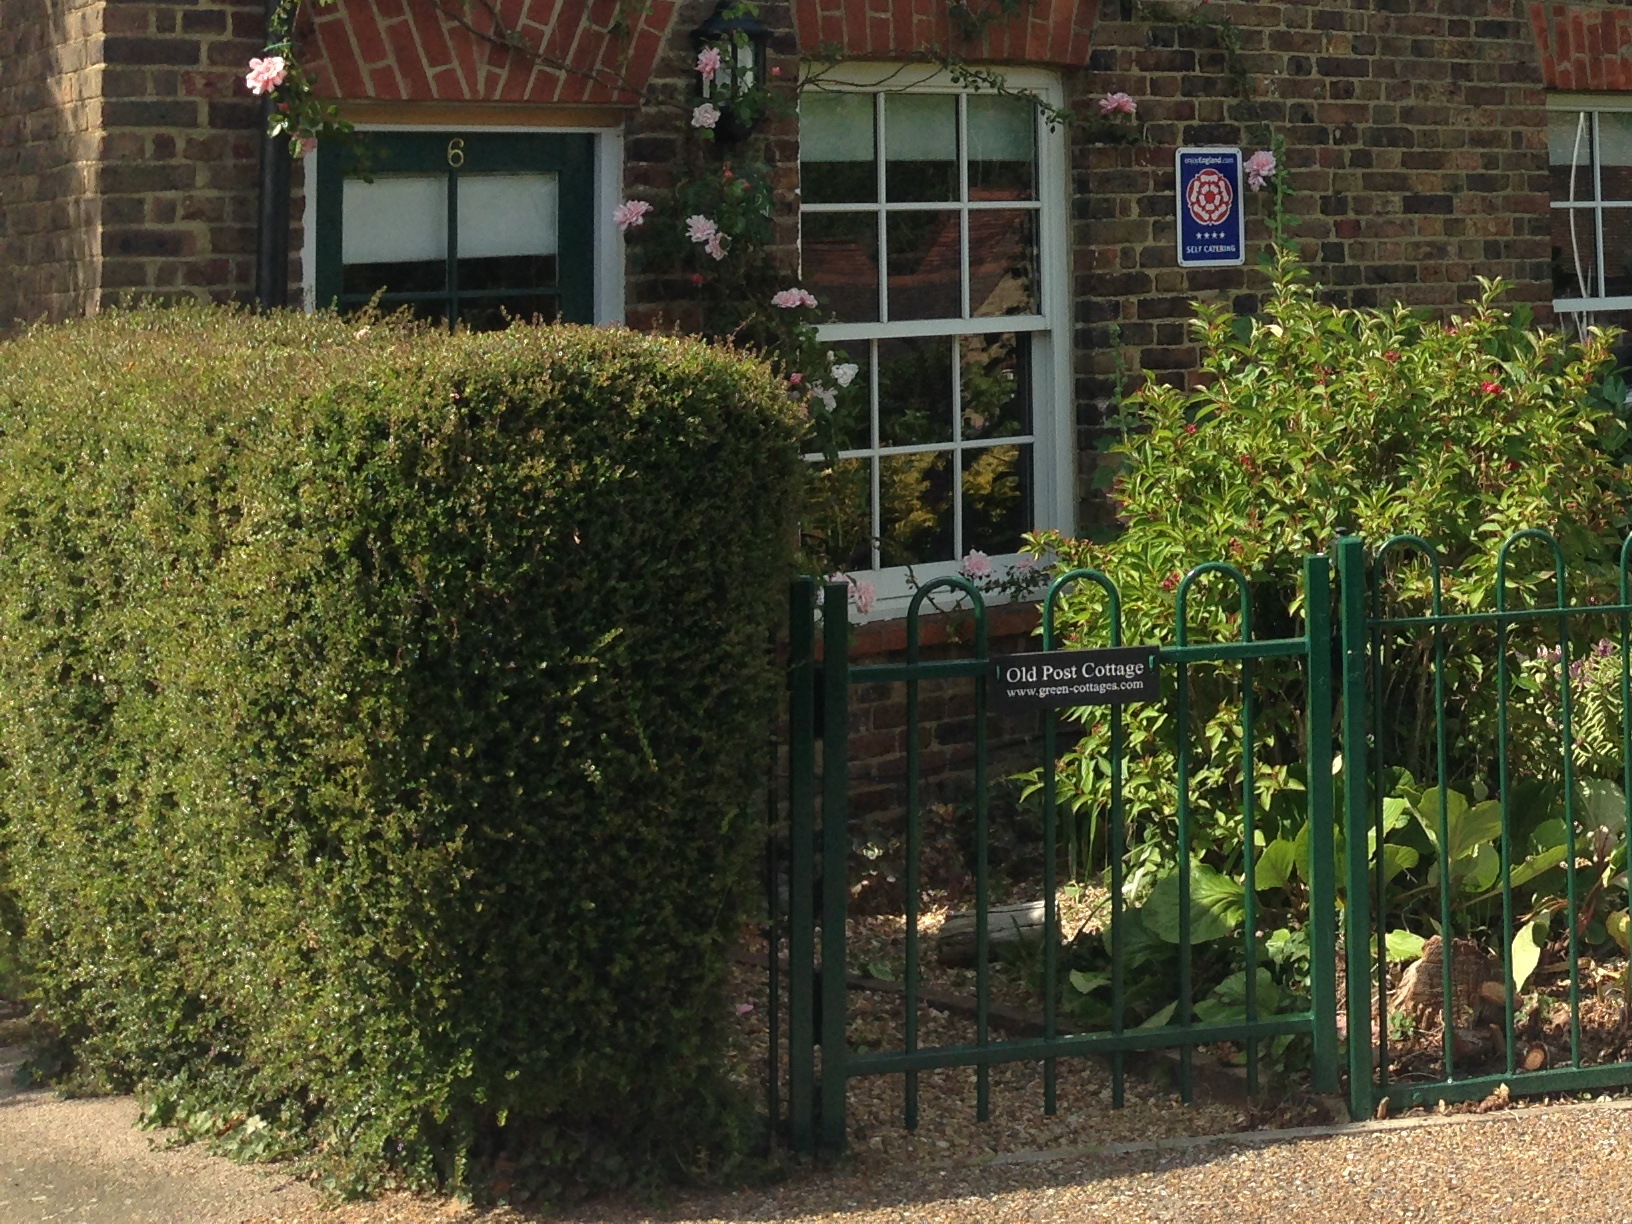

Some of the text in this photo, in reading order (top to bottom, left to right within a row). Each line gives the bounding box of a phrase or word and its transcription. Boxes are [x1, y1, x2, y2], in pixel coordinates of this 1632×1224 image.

[447, 137, 465, 168] 6
[1186, 244, 1236, 254] SELF CATERING
[1006, 662, 1144, 683] Old Post Cottage
[1006, 680, 1144, 698] www.green-cottages.com
